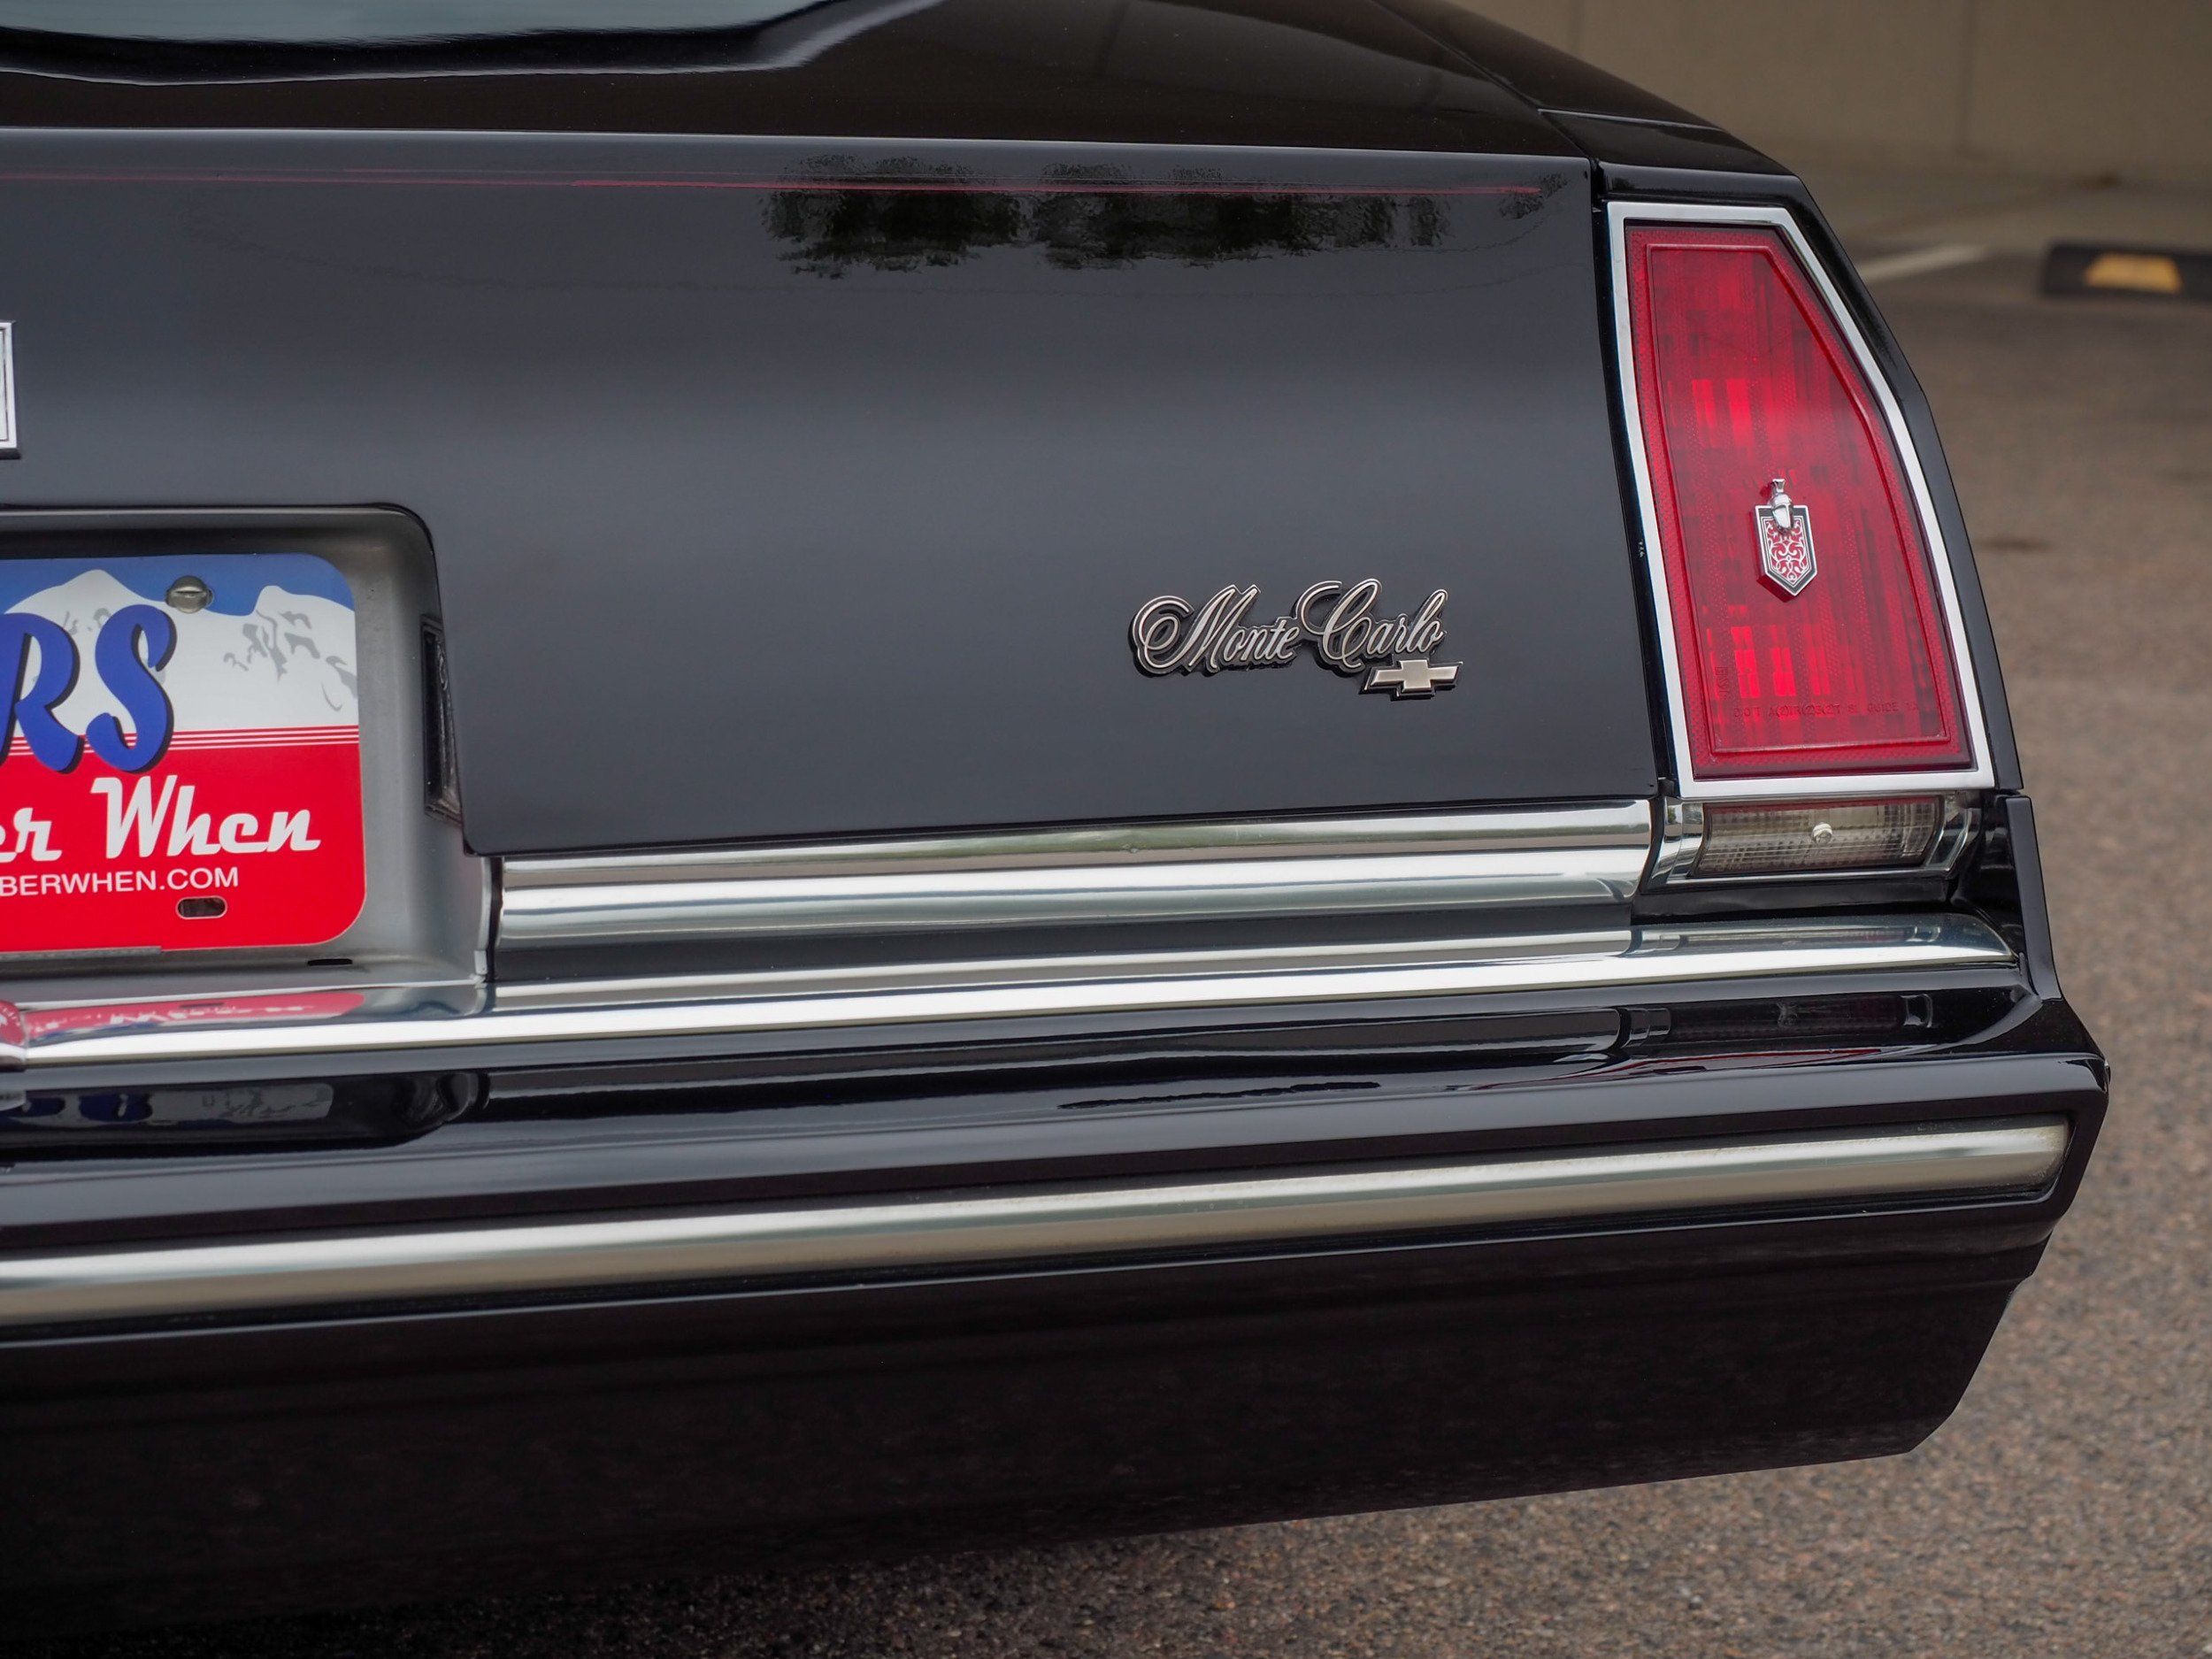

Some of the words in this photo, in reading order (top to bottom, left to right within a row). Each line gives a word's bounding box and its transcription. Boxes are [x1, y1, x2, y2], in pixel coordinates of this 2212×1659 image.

[1133, 584, 1301, 673] Monte
[1297, 578, 1448, 672] Carlo
[90, 775, 321, 859] When
